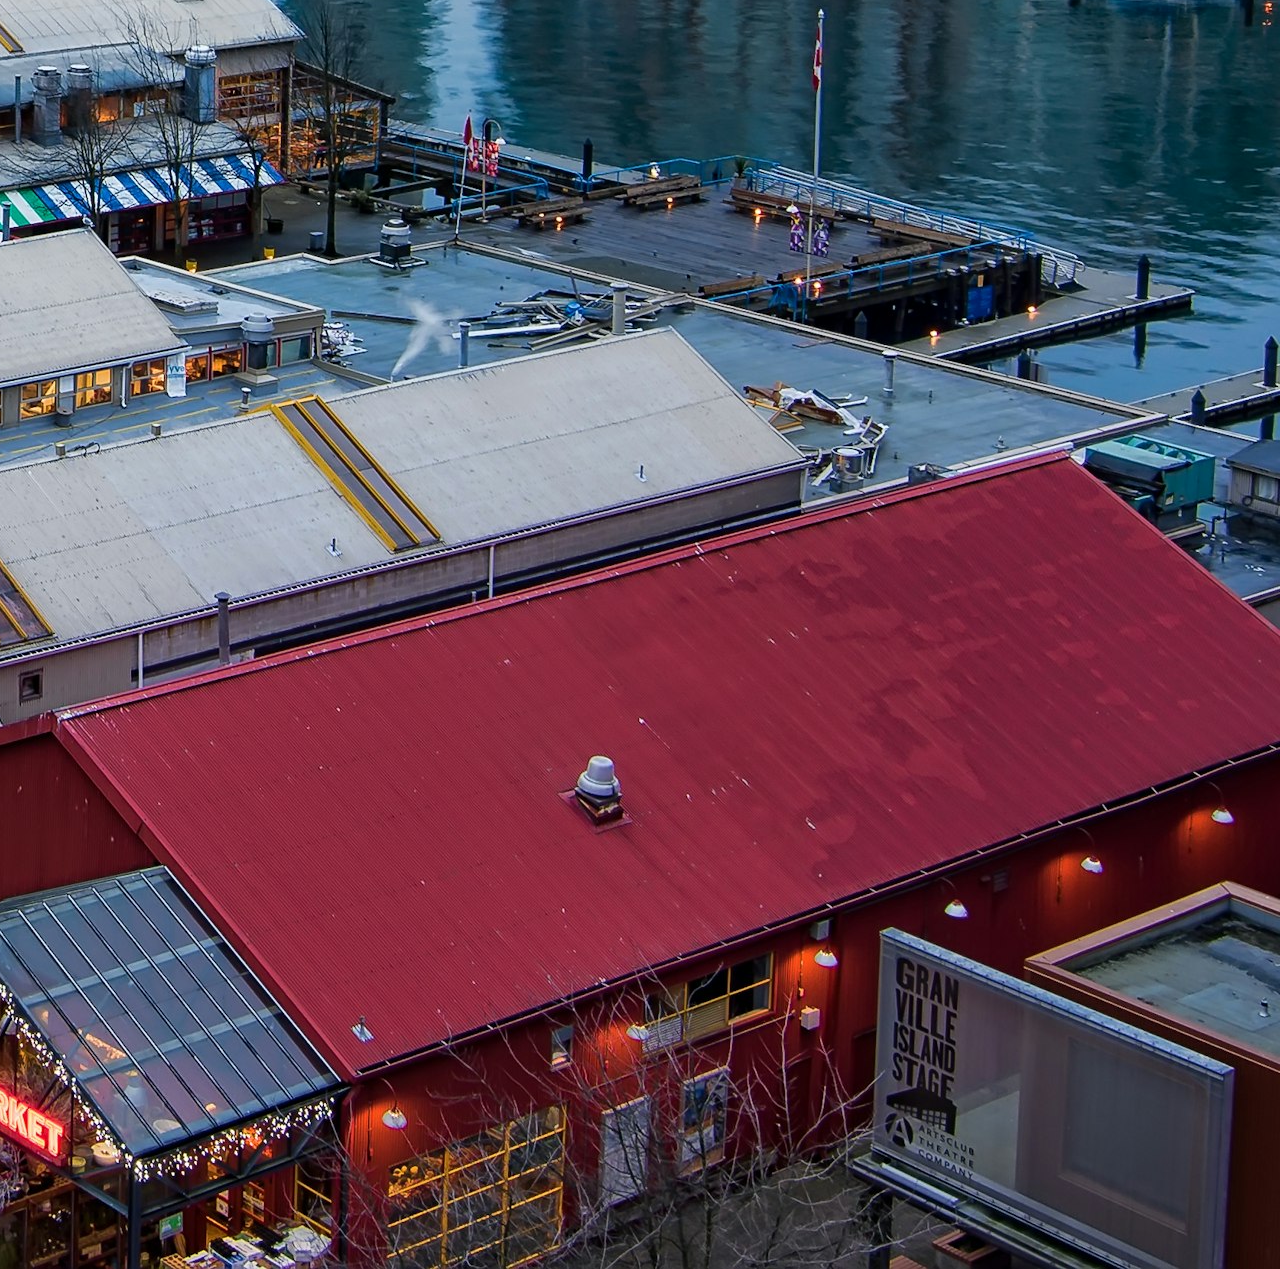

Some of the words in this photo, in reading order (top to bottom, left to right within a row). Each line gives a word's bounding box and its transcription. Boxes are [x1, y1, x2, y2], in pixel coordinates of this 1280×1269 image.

[896, 957, 959, 1011] GRAN
[896, 988, 958, 1047] VILLE
[894, 1021, 956, 1075] ISLAND
[892, 1052, 955, 1100] STAGE
[918, 1124, 975, 1156] ARTSCLUB
[918, 1136, 975, 1169] THEATRE
[918, 1149, 974, 1180] COMPANY
